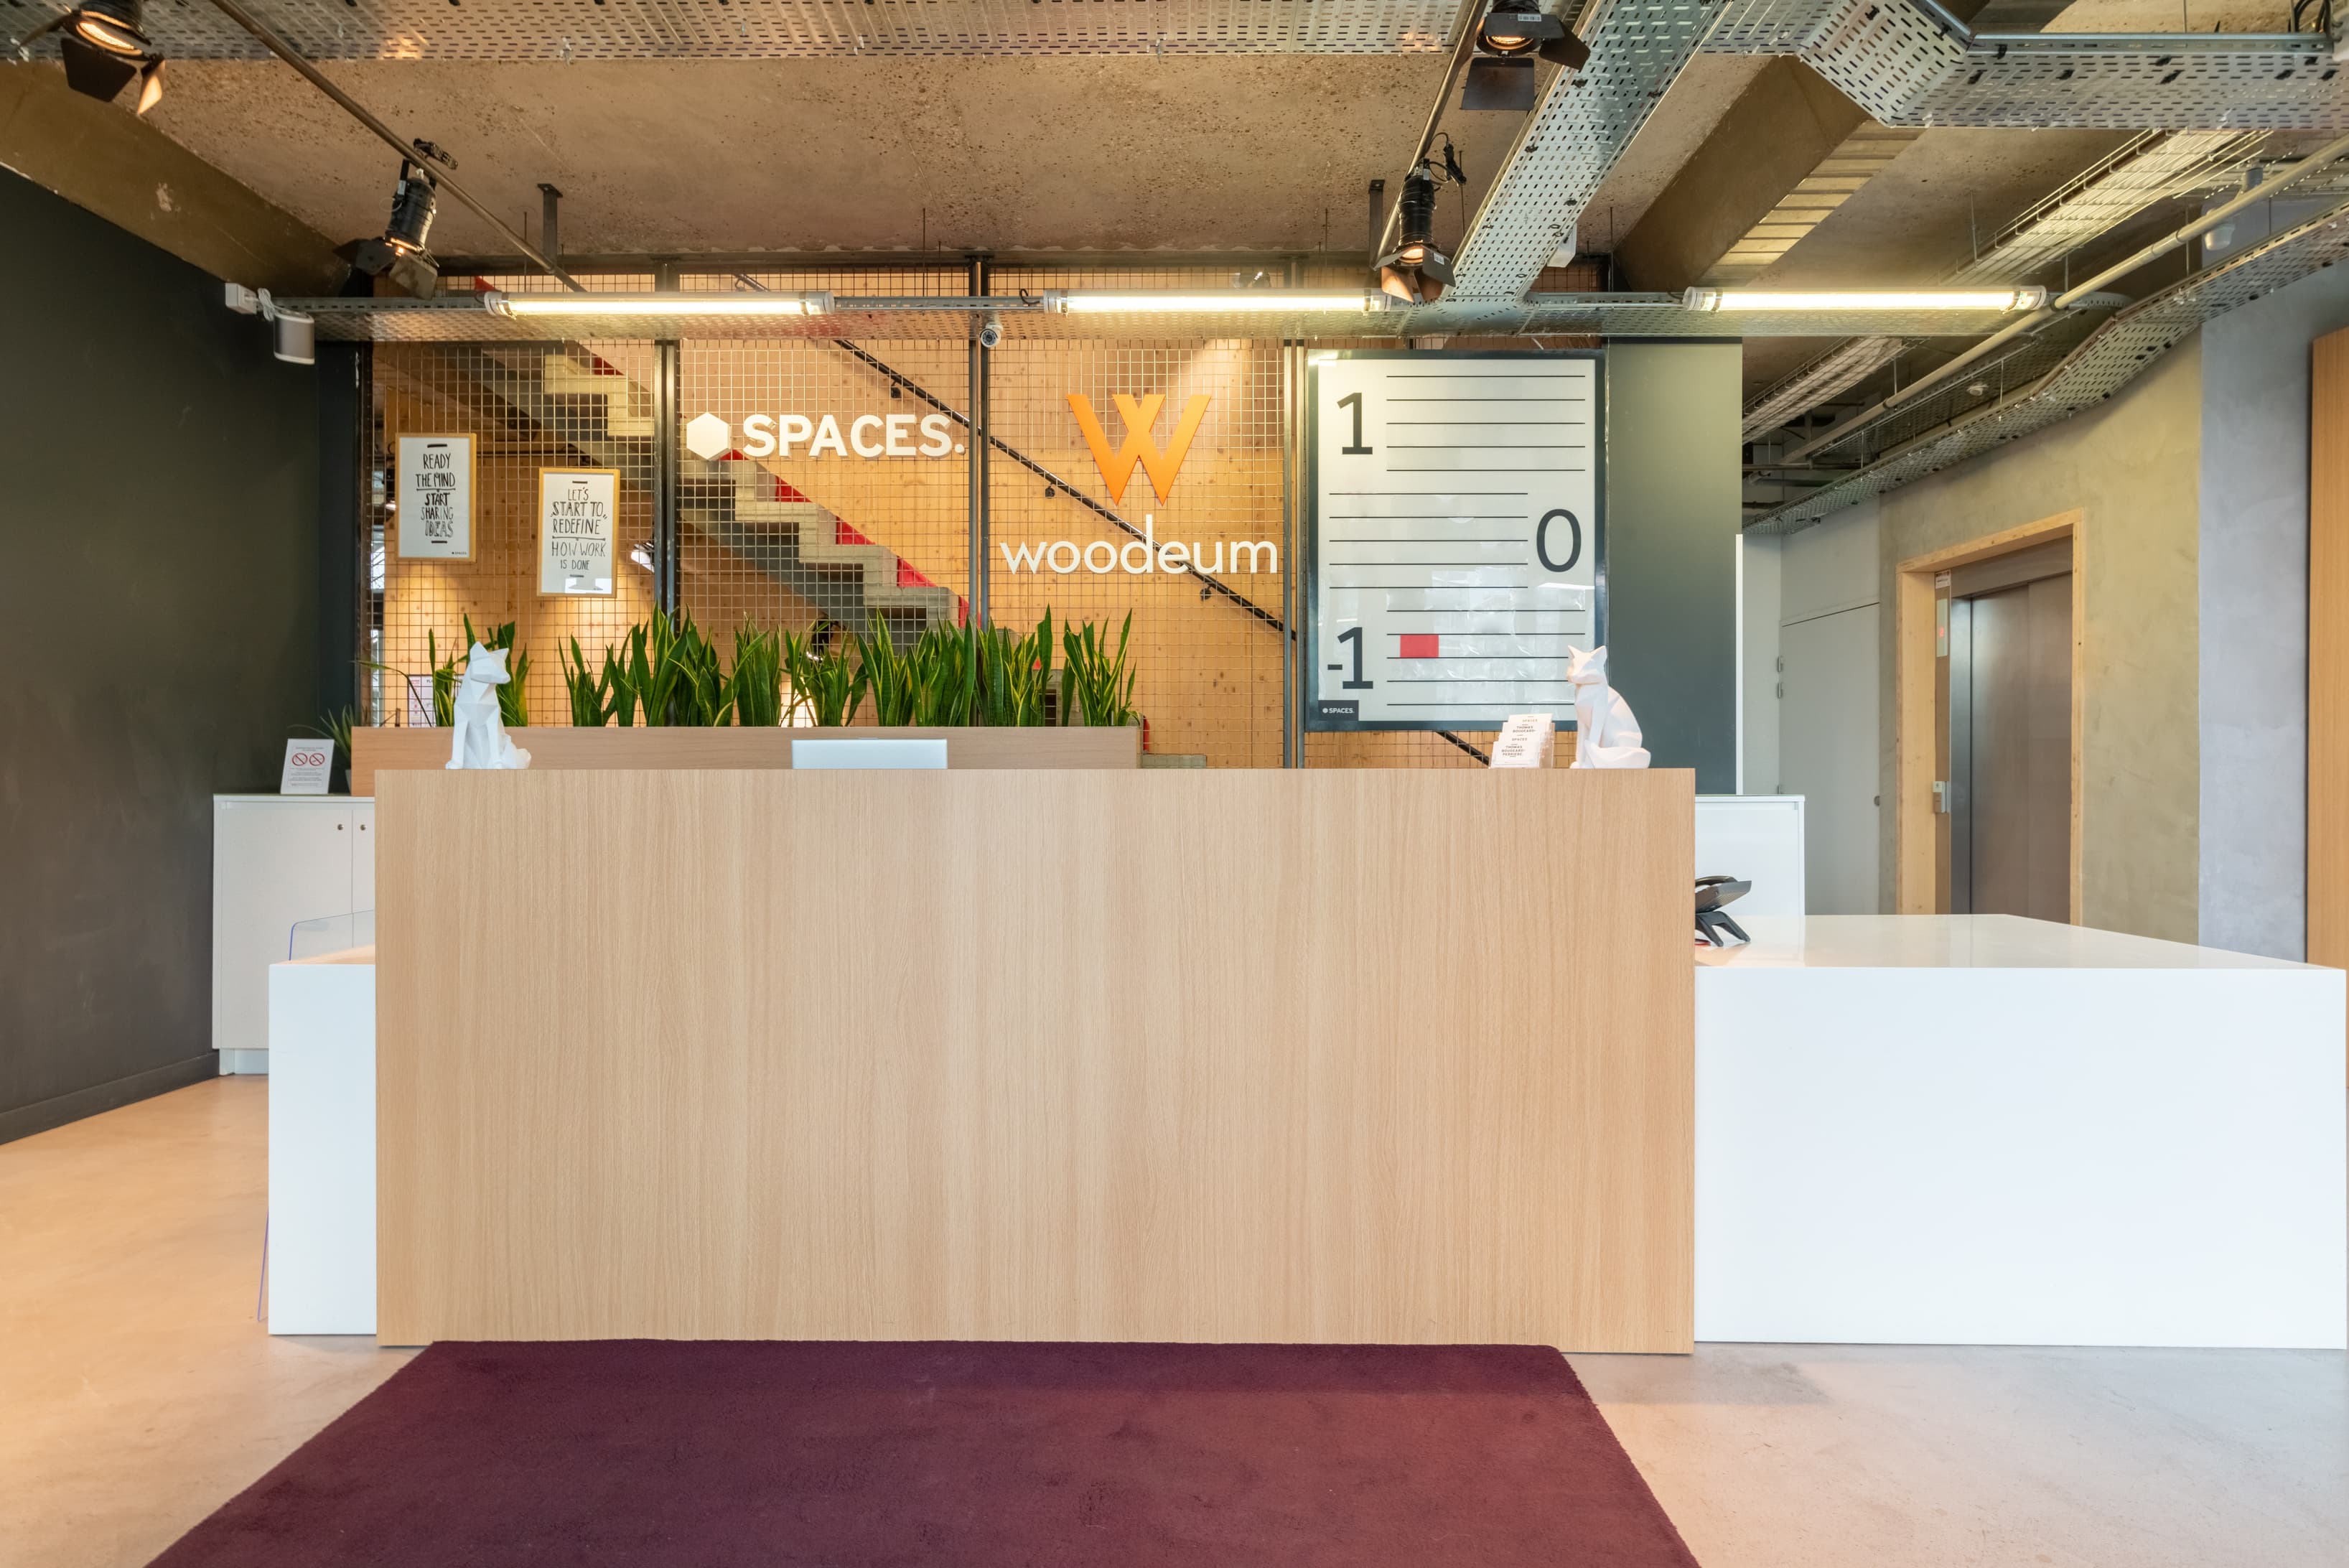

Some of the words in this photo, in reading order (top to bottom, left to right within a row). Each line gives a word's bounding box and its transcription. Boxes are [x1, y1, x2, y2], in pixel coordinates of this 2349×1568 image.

[1336, 392, 1373, 455] 1
[742, 414, 966, 458] SPACES.
[423, 452, 452, 470] READY
[415, 473, 432, 487] THE
[434, 472, 456, 487] MIND
[424, 492, 451, 506] START
[568, 486, 589, 501] LET'S
[421, 506, 454, 521] SHARING
[551, 500, 588, 517] START
[425, 521, 454, 538] IDEAS
[553, 518, 602, 535] REDEFINE
[999, 513, 1278, 575] woodeum
[1536, 508, 1582, 573] 0
[551, 541, 578, 557] HOW
[579, 541, 607, 558] WORK
[560, 559, 567, 569] IS
[571, 559, 590, 571] DONE
[1327, 626, 1374, 690] -1
